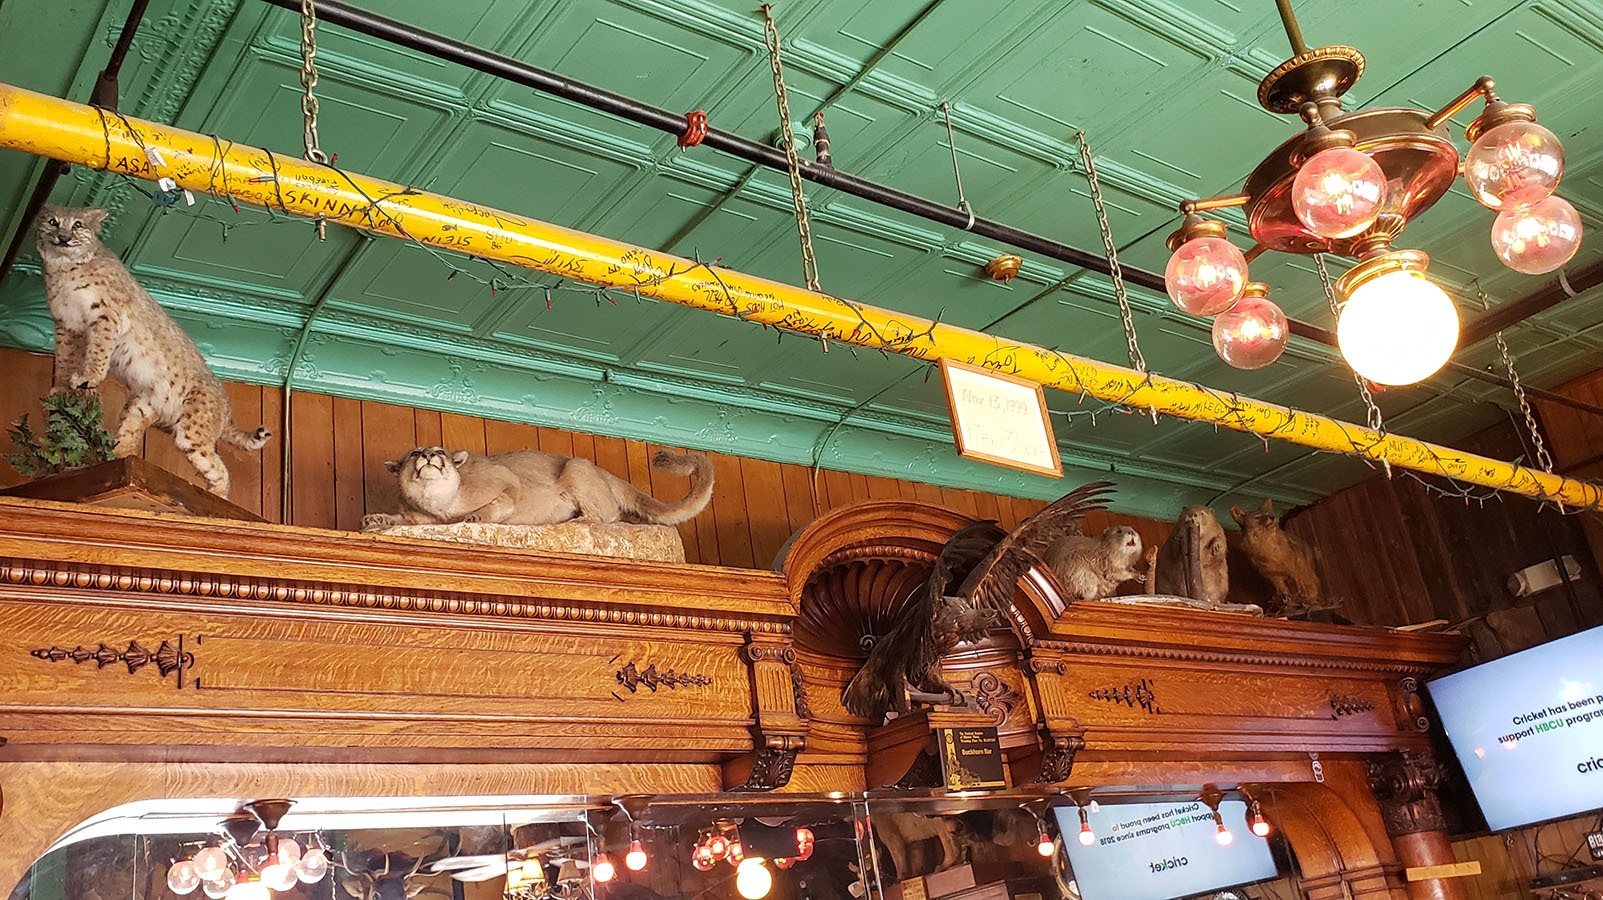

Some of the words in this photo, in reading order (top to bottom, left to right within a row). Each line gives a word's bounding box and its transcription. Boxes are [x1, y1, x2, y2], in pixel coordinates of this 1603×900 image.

[116, 157, 150, 175] ASA
[1512, 708, 1548, 725] Cricket
[1548, 705, 1567, 716] has
[1567, 697, 1595, 710] been
[1498, 727, 1534, 744] support
[1535, 718, 1564, 733] HBCU
